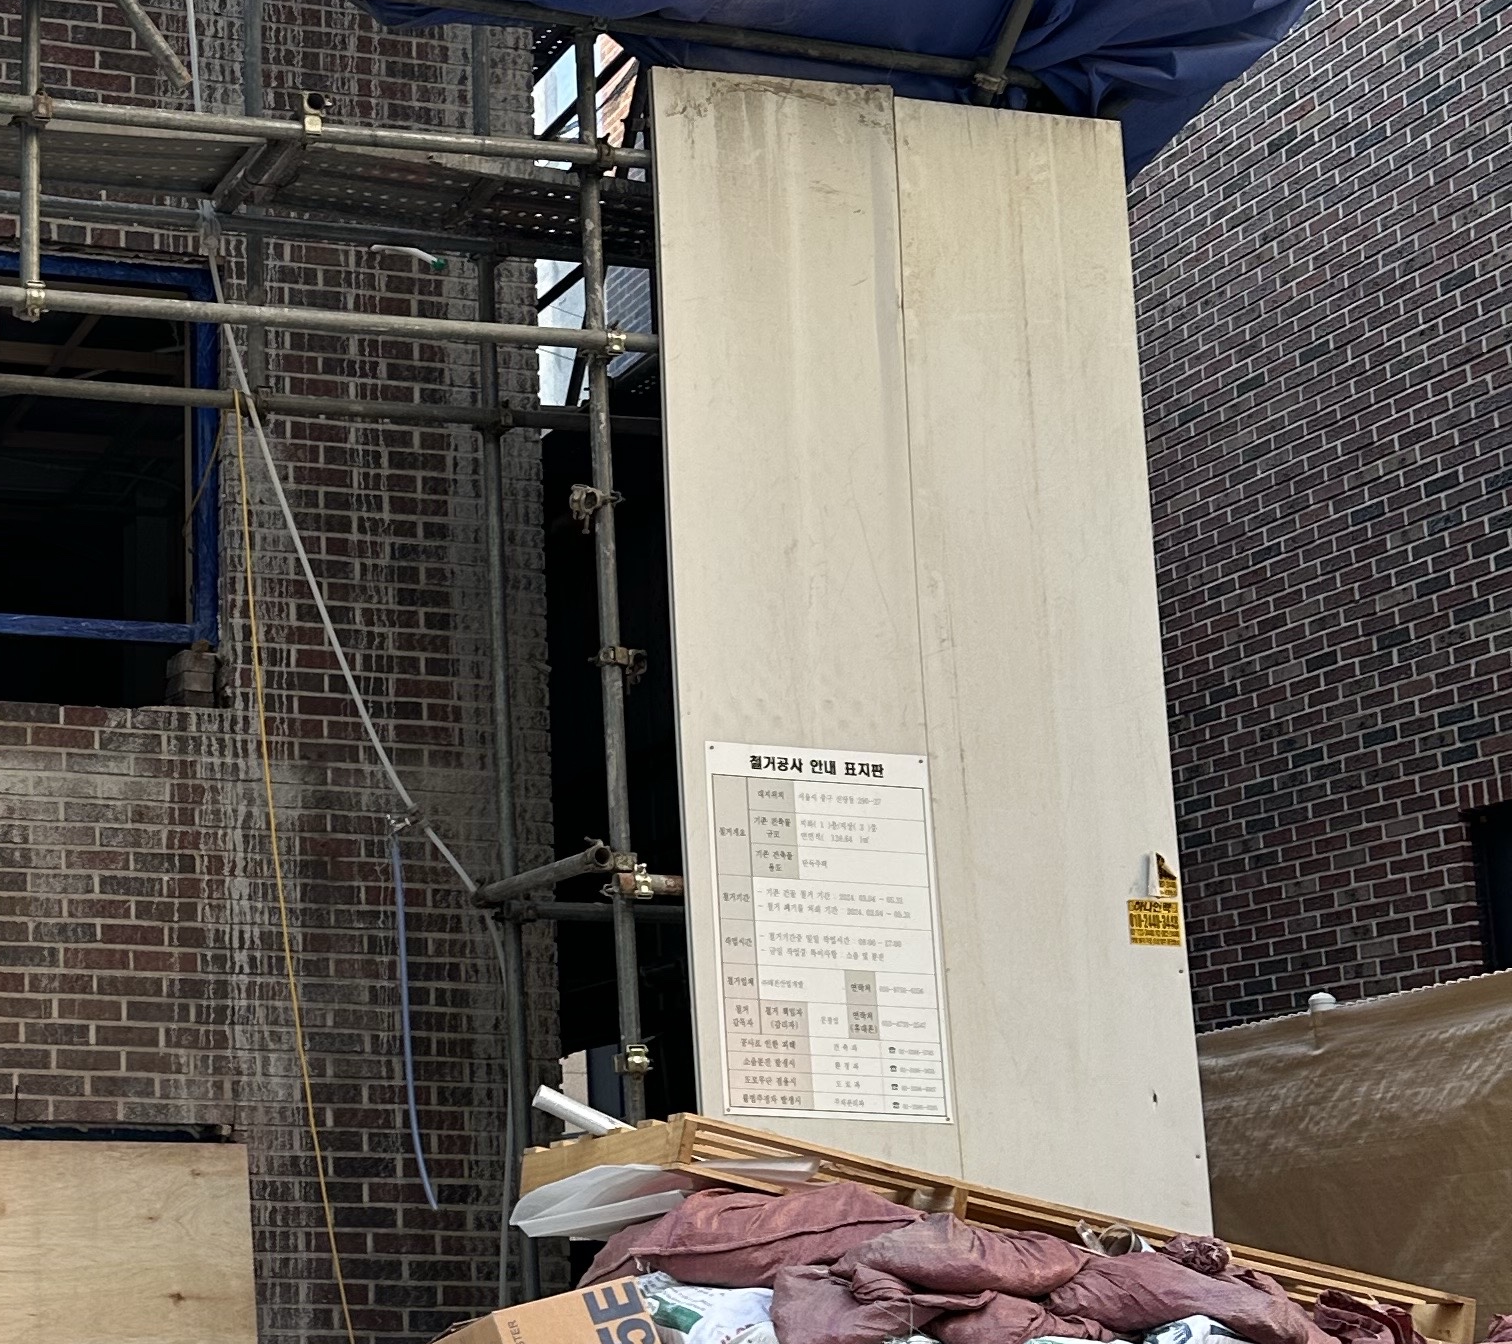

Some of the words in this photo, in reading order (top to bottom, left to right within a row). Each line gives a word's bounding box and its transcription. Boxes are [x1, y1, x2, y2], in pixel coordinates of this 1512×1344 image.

[749, 754, 803, 773] 철거공사
[809, 758, 836, 775] 안내
[843, 761, 884, 779] 표지판
